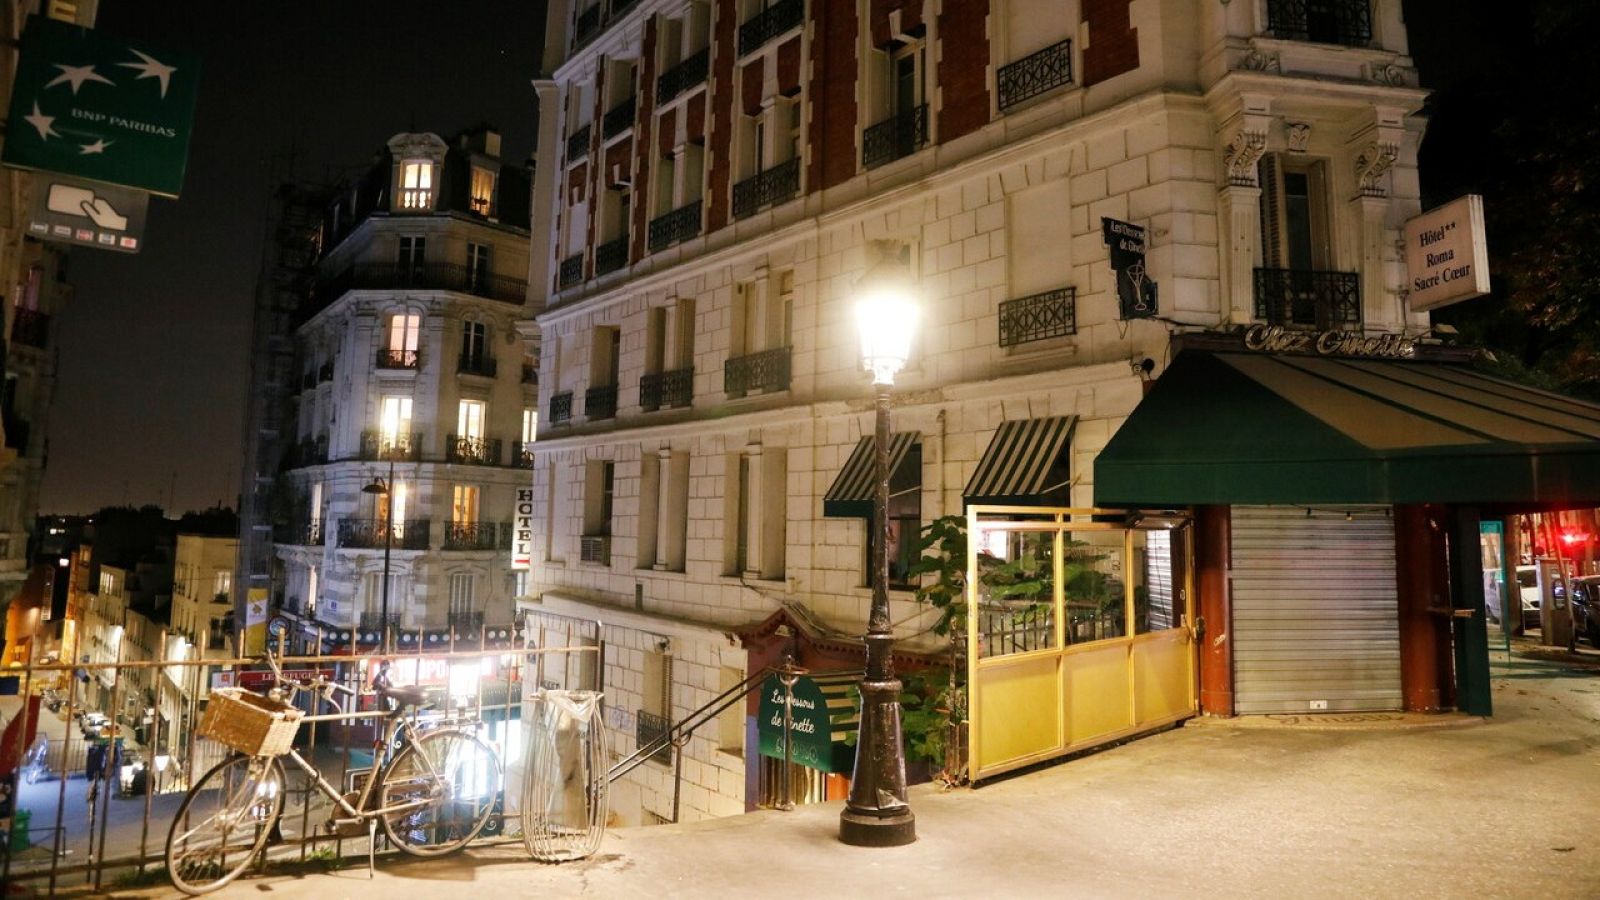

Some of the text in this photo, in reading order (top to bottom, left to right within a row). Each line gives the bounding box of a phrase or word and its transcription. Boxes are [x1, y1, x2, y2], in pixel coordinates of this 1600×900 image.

[71, 108, 177, 137] BNP PARIBAS
[1419, 226, 1445, 247] Hôtel
[1426, 249, 1454, 268] Roma
[1414, 265, 1471, 292] Sacré Cœur
[1244, 324, 1416, 359] Chez Ginette
[518, 489, 533, 555] HOTEL
[280, 671, 313, 681] EFUG
[771, 689, 815, 710] Les essous
[771, 710, 815, 734] de inette
